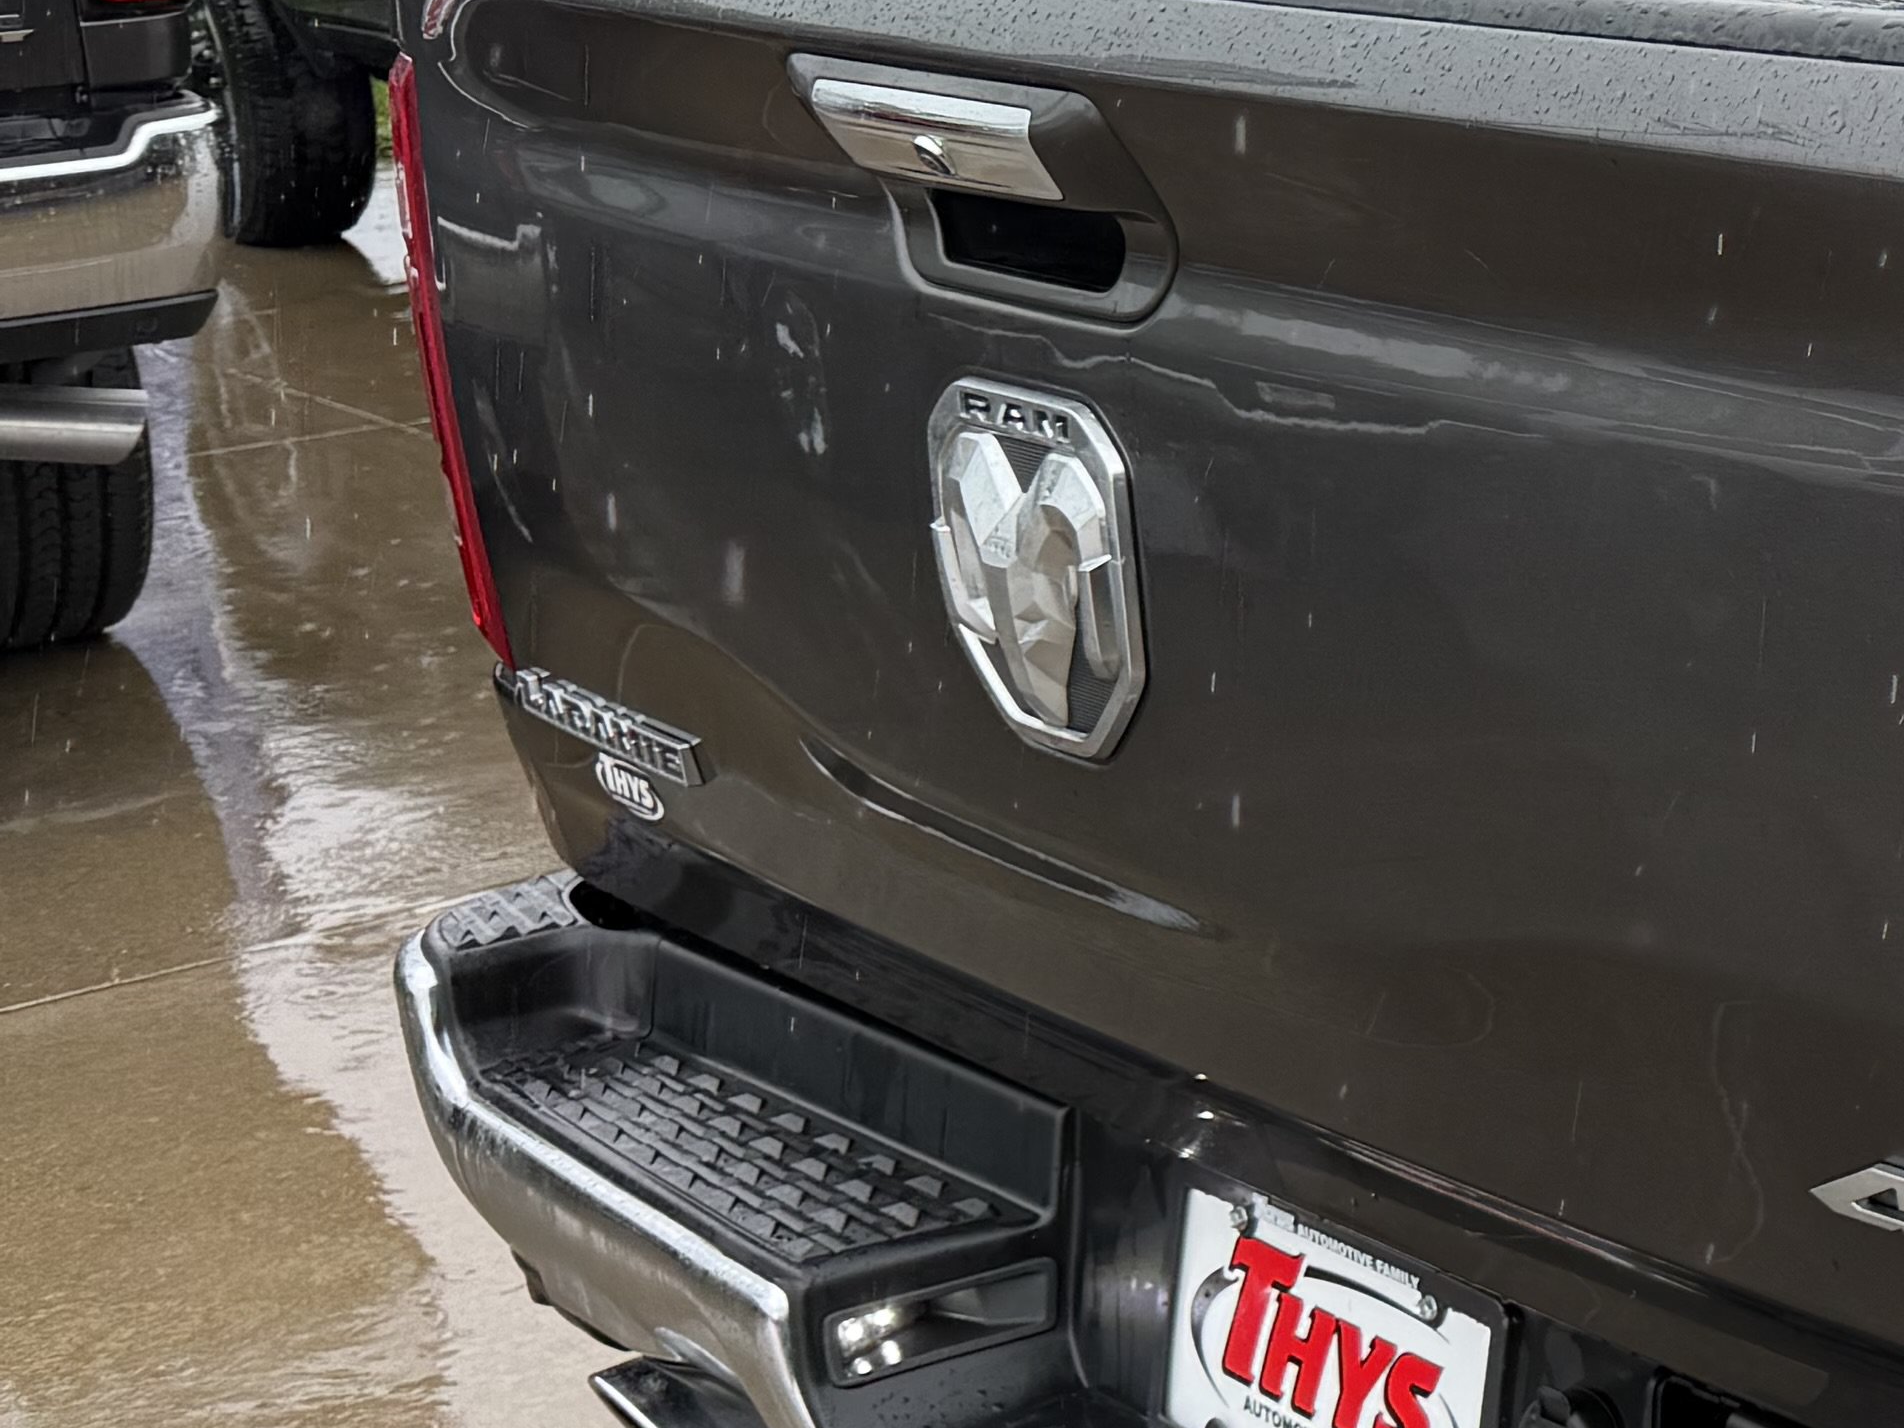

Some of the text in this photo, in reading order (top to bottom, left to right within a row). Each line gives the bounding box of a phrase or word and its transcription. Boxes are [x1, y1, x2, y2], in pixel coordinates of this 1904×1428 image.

[958, 389, 1071, 443] RAM
[602, 754, 655, 808] THYS
[1297, 1223, 1374, 1269] AUTOMOTIVE
[1375, 1259, 1420, 1289] FAMILY
